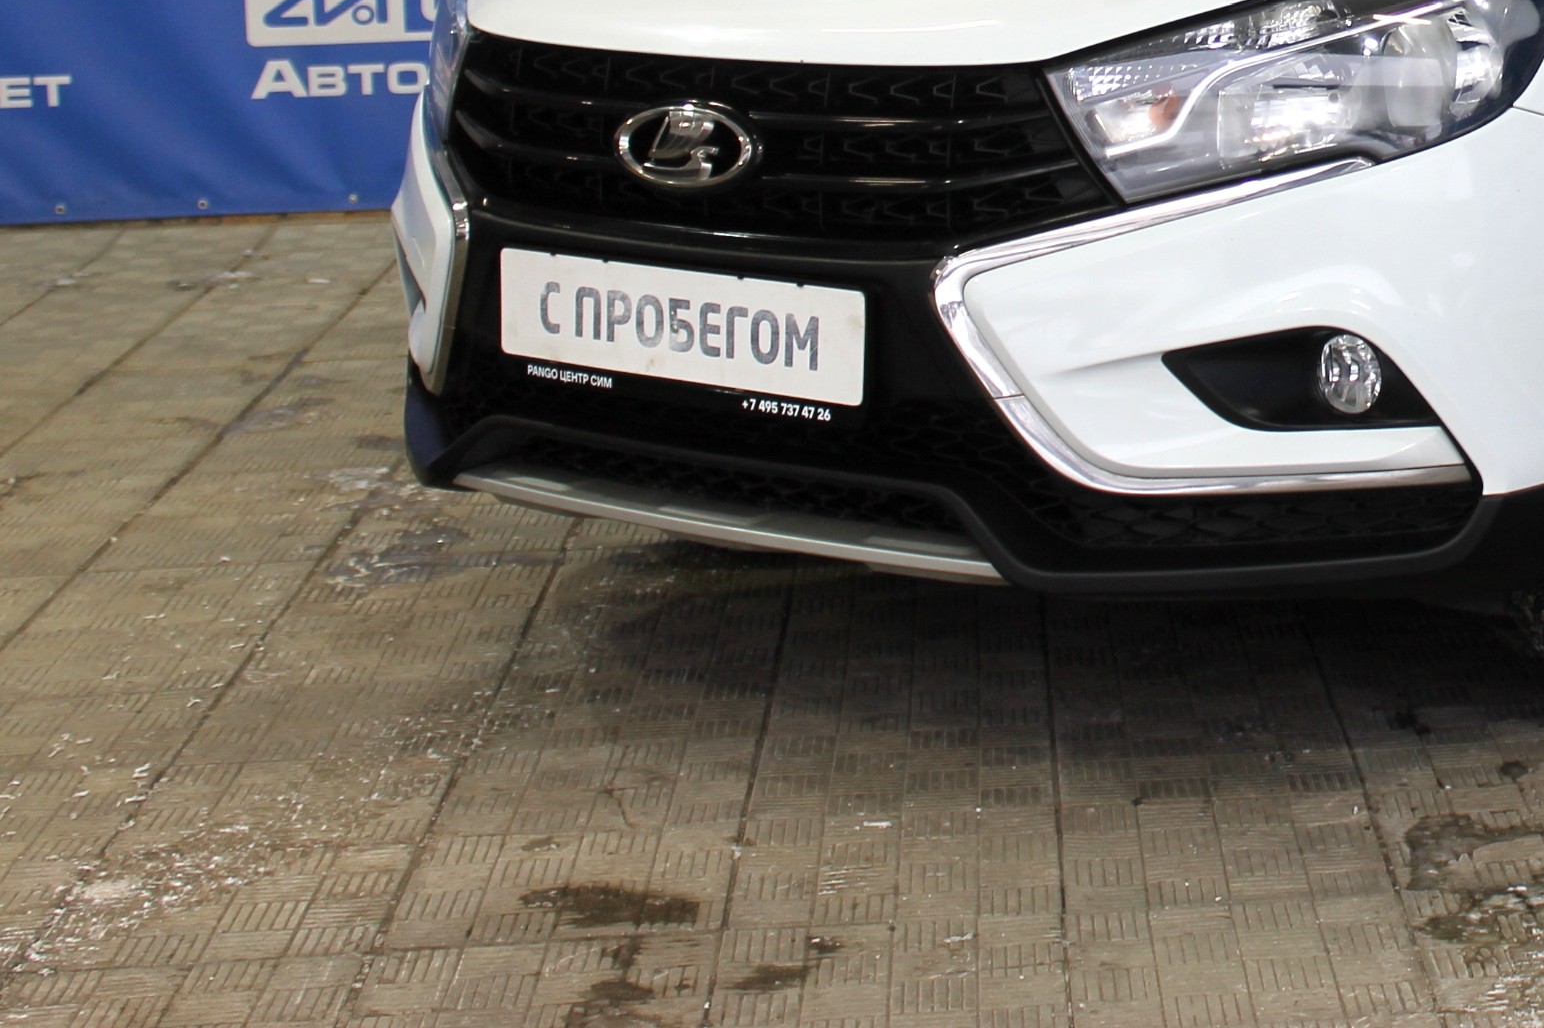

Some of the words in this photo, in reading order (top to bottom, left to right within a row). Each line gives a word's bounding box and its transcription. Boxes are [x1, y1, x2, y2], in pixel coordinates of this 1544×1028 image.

[540, 280, 561, 335] С
[575, 286, 820, 371] ПРОБЕГОМ
[527, 364, 558, 380] PANGO
[560, 370, 589, 385] ЦЕНТР
[590, 375, 613, 389] СИМ
[742, 398, 757, 411] +7
[758, 399, 779, 414] 495
[780, 402, 800, 417] 737
[801, 405, 815, 419] 47
[817, 407, 832, 422] 26
